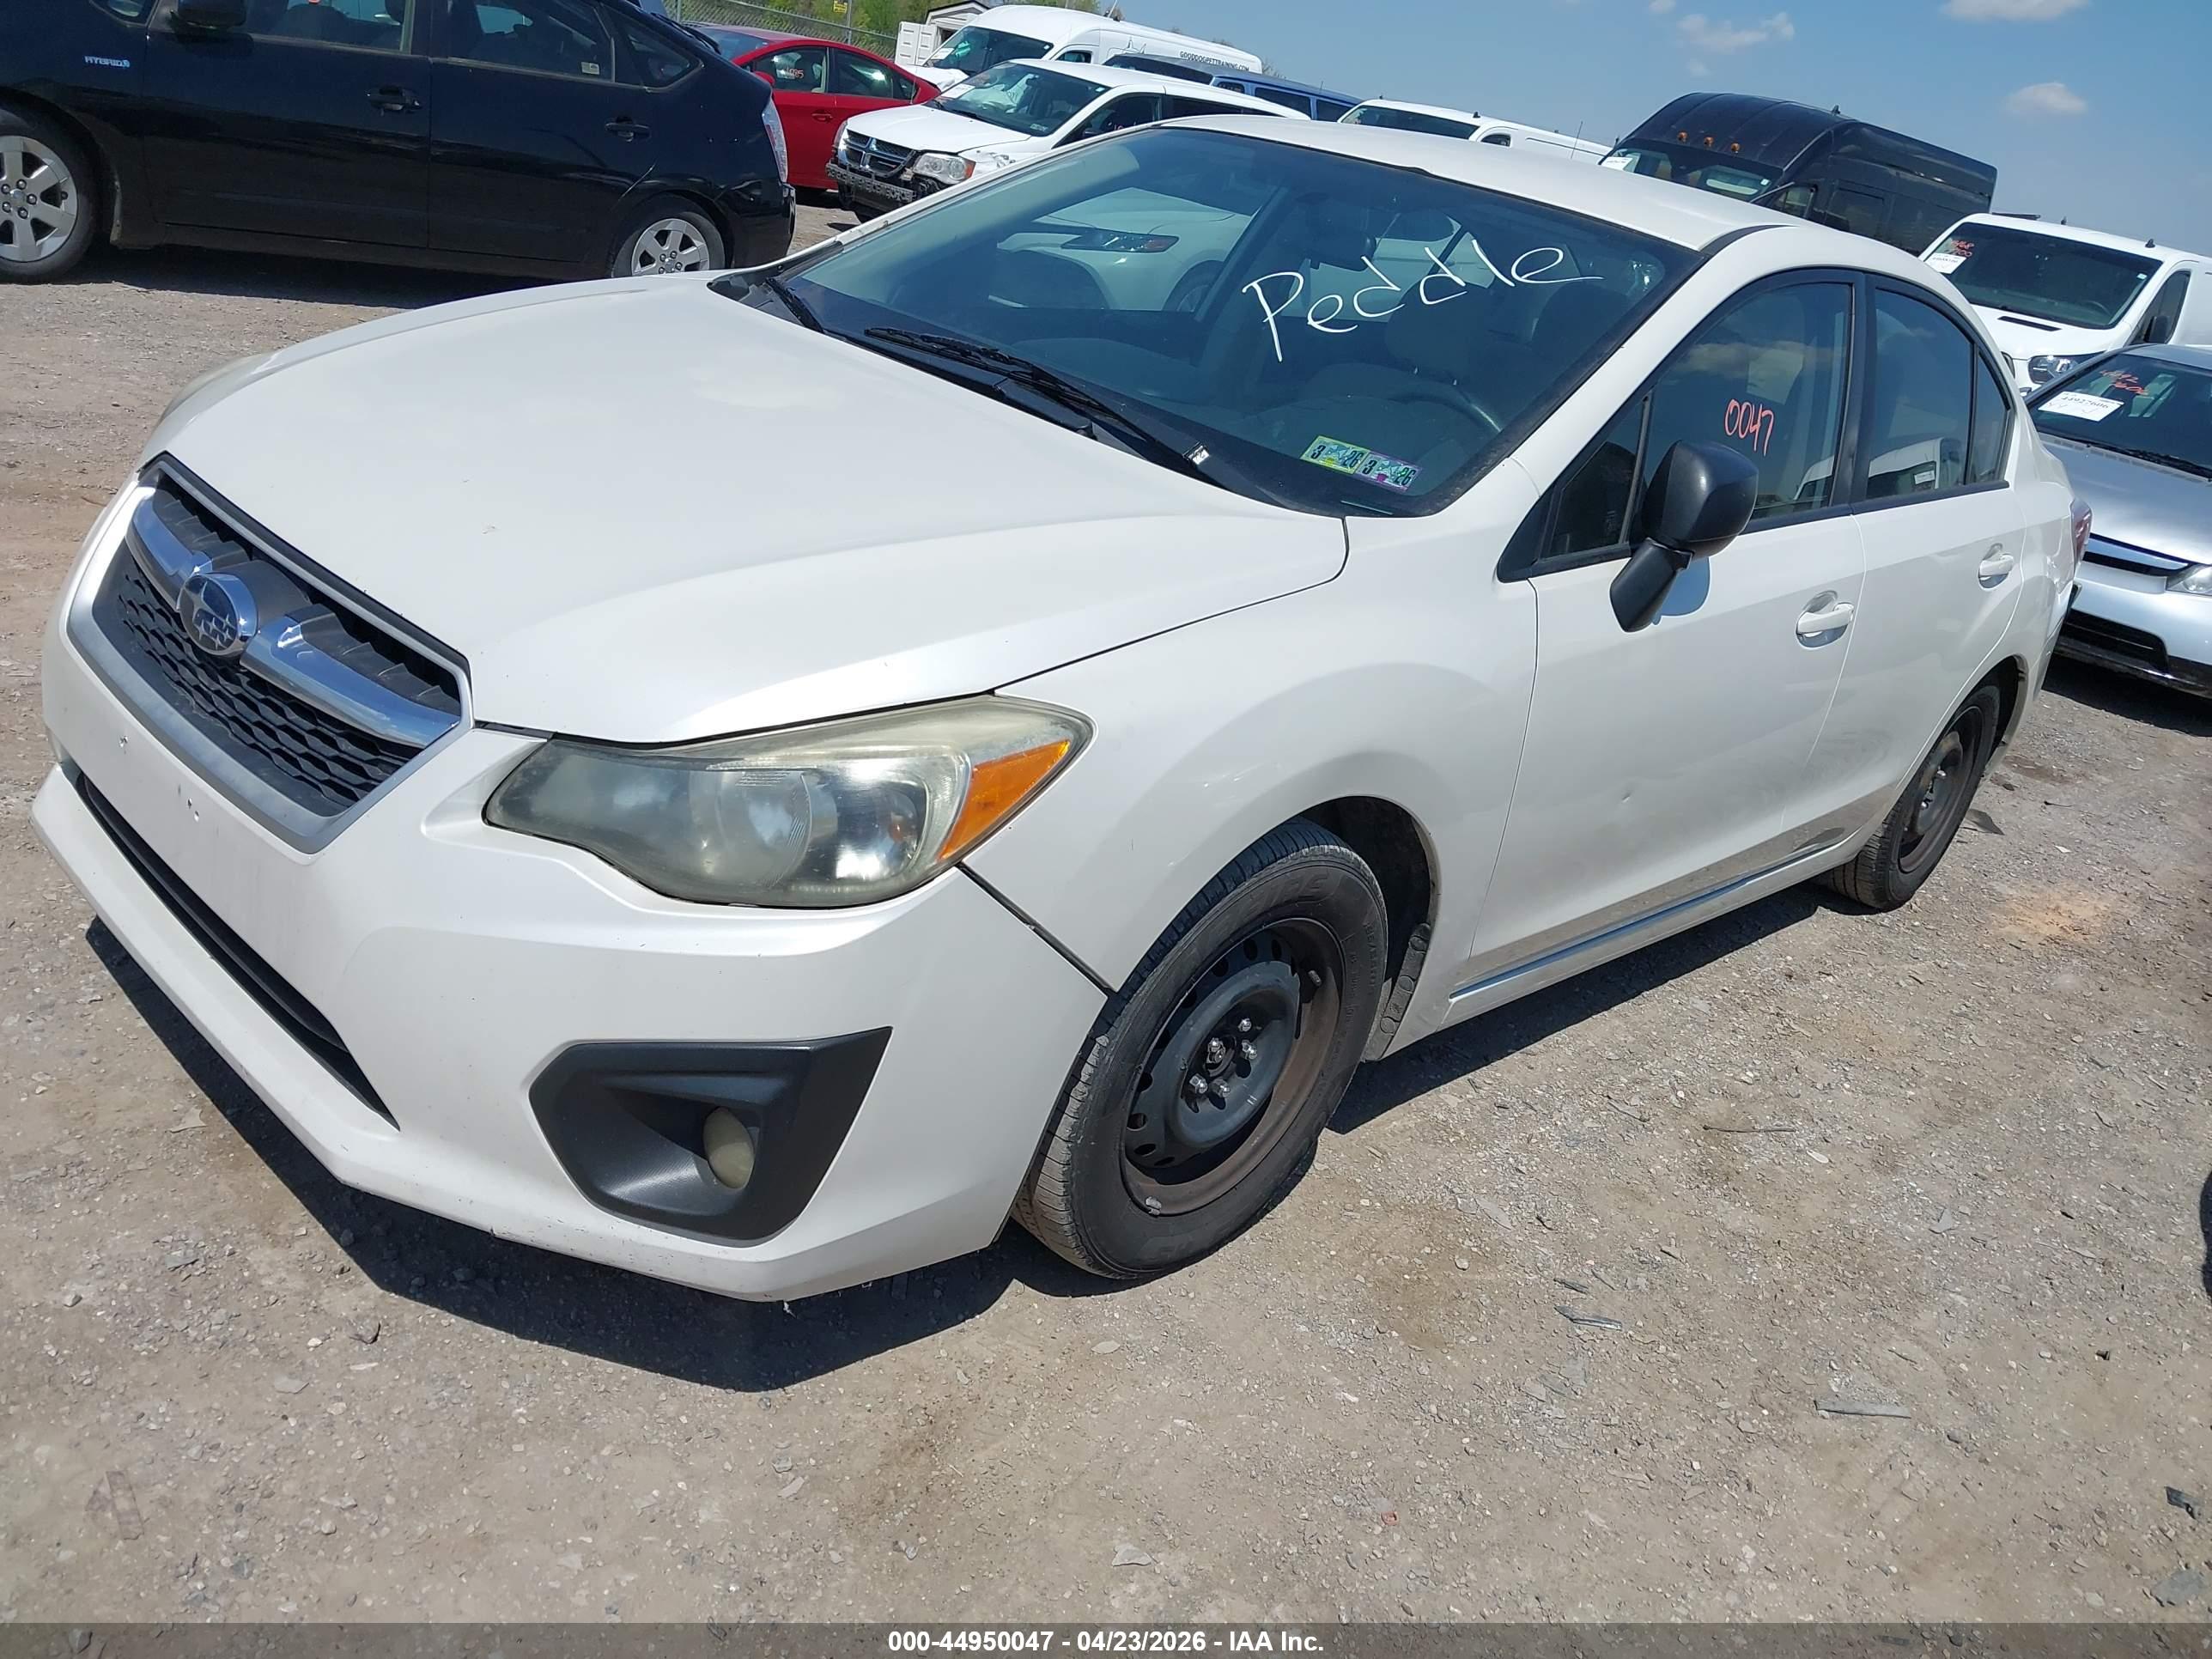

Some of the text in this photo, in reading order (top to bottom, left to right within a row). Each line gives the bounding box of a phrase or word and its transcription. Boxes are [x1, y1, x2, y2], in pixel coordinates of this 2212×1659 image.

[84, 56, 124, 68] HYBRID
[1242, 239, 1605, 363] Peddle
[1724, 398, 1774, 457] 0047
[1310, 445, 1364, 468] 3 26
[1362, 459, 1416, 486] 3 26
